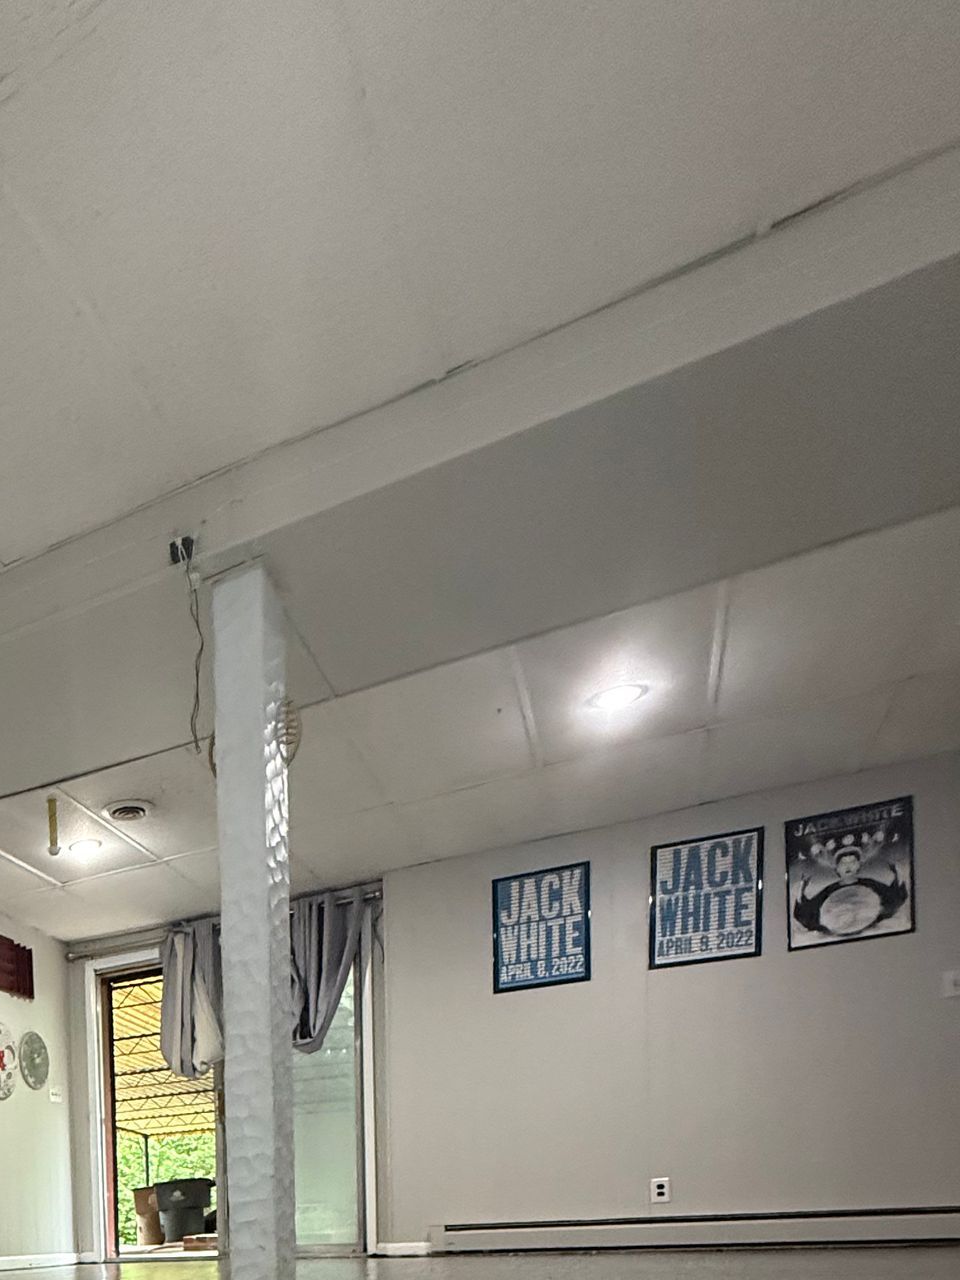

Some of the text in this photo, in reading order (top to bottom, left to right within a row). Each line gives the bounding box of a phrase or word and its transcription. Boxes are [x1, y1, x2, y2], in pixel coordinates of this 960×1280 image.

[659, 834, 754, 895] JACK
[500, 868, 581, 925] JACK
[659, 886, 754, 938] WHITE
[500, 915, 582, 966] WHITE
[657, 936, 694, 957] APRIL
[716, 929, 754, 950] 2022
[500, 962, 534, 982] APRIL
[551, 954, 585, 976] 2022
